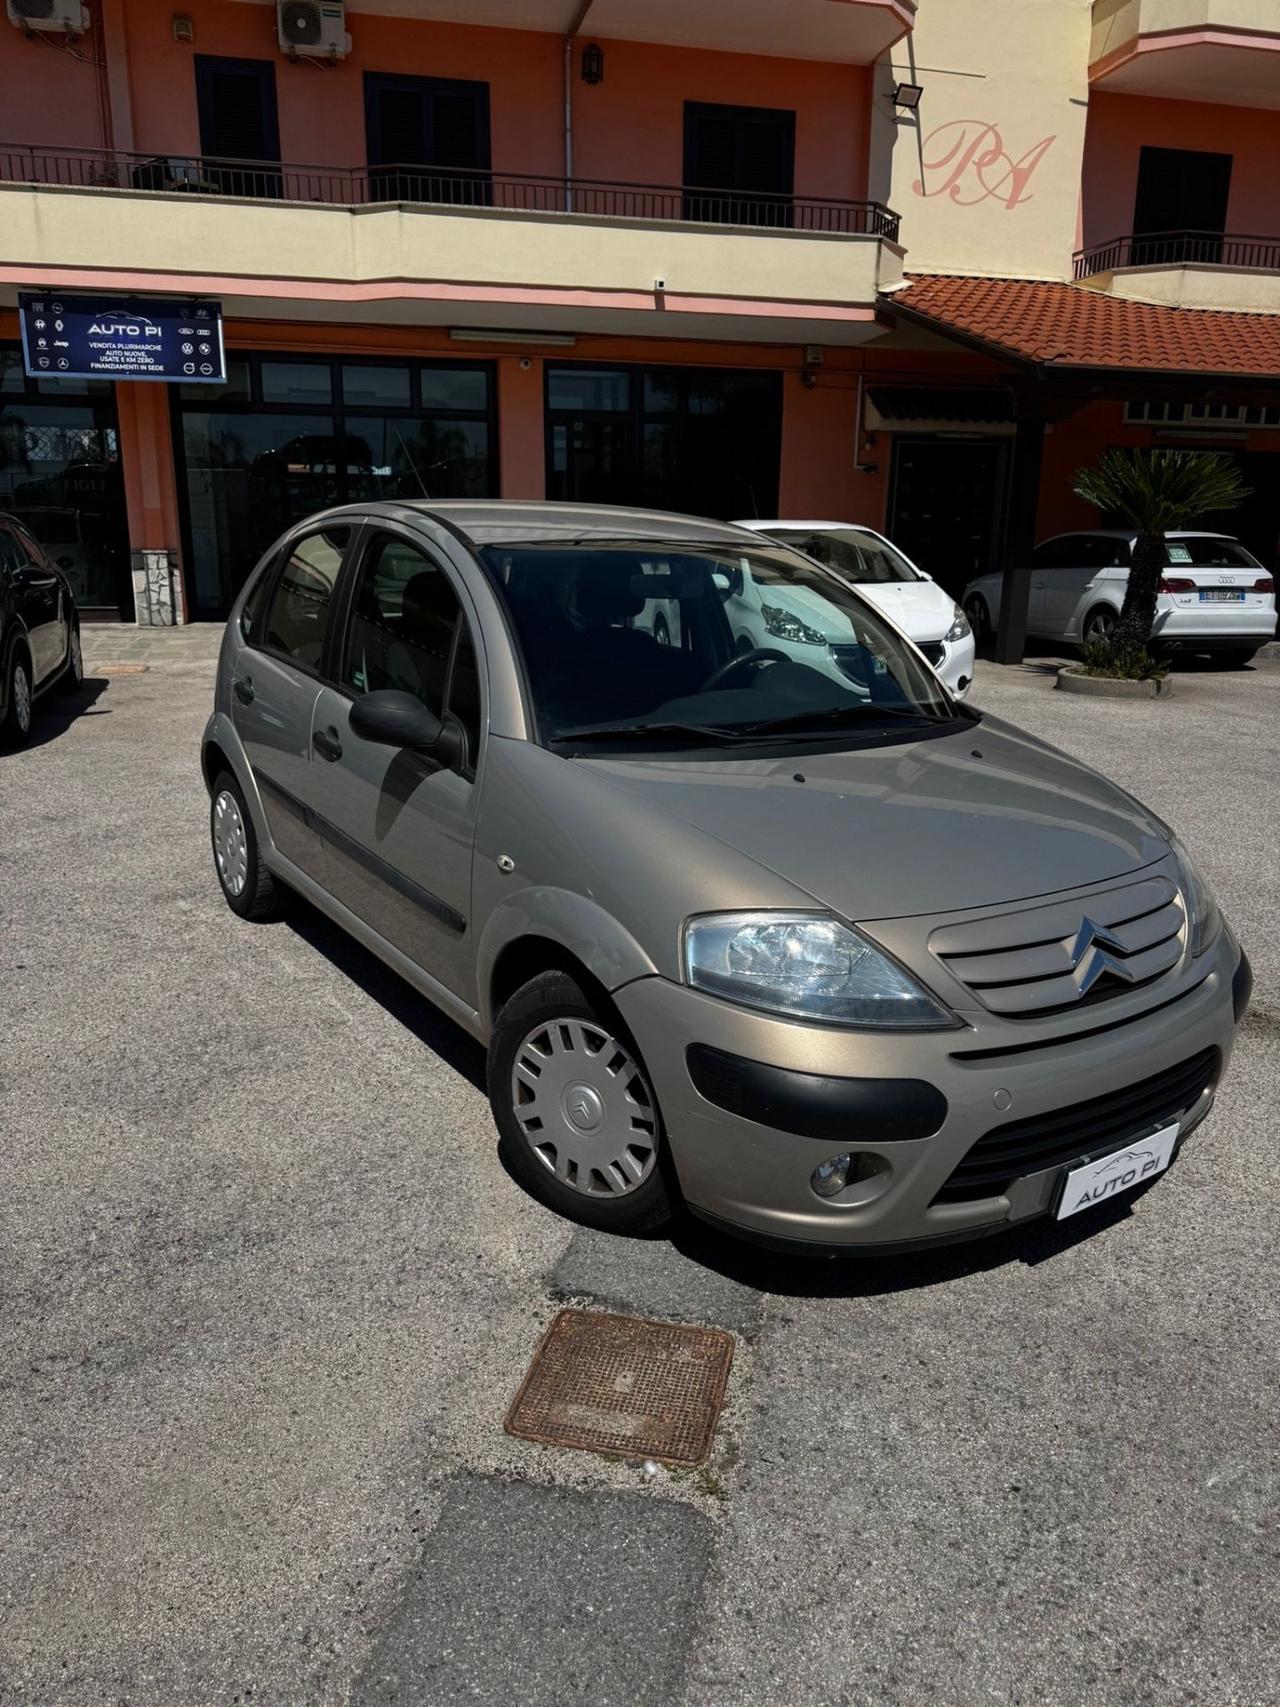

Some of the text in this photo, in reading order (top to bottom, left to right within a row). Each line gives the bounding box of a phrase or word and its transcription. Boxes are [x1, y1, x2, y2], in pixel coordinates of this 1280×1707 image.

[87, 323, 162, 337] AUTO PI
[117, 343, 162, 351] PLURIMARCHE
[90, 362, 139, 370] FINANZIAMENTI
[1074, 1155, 1160, 1209] AUTO PI
